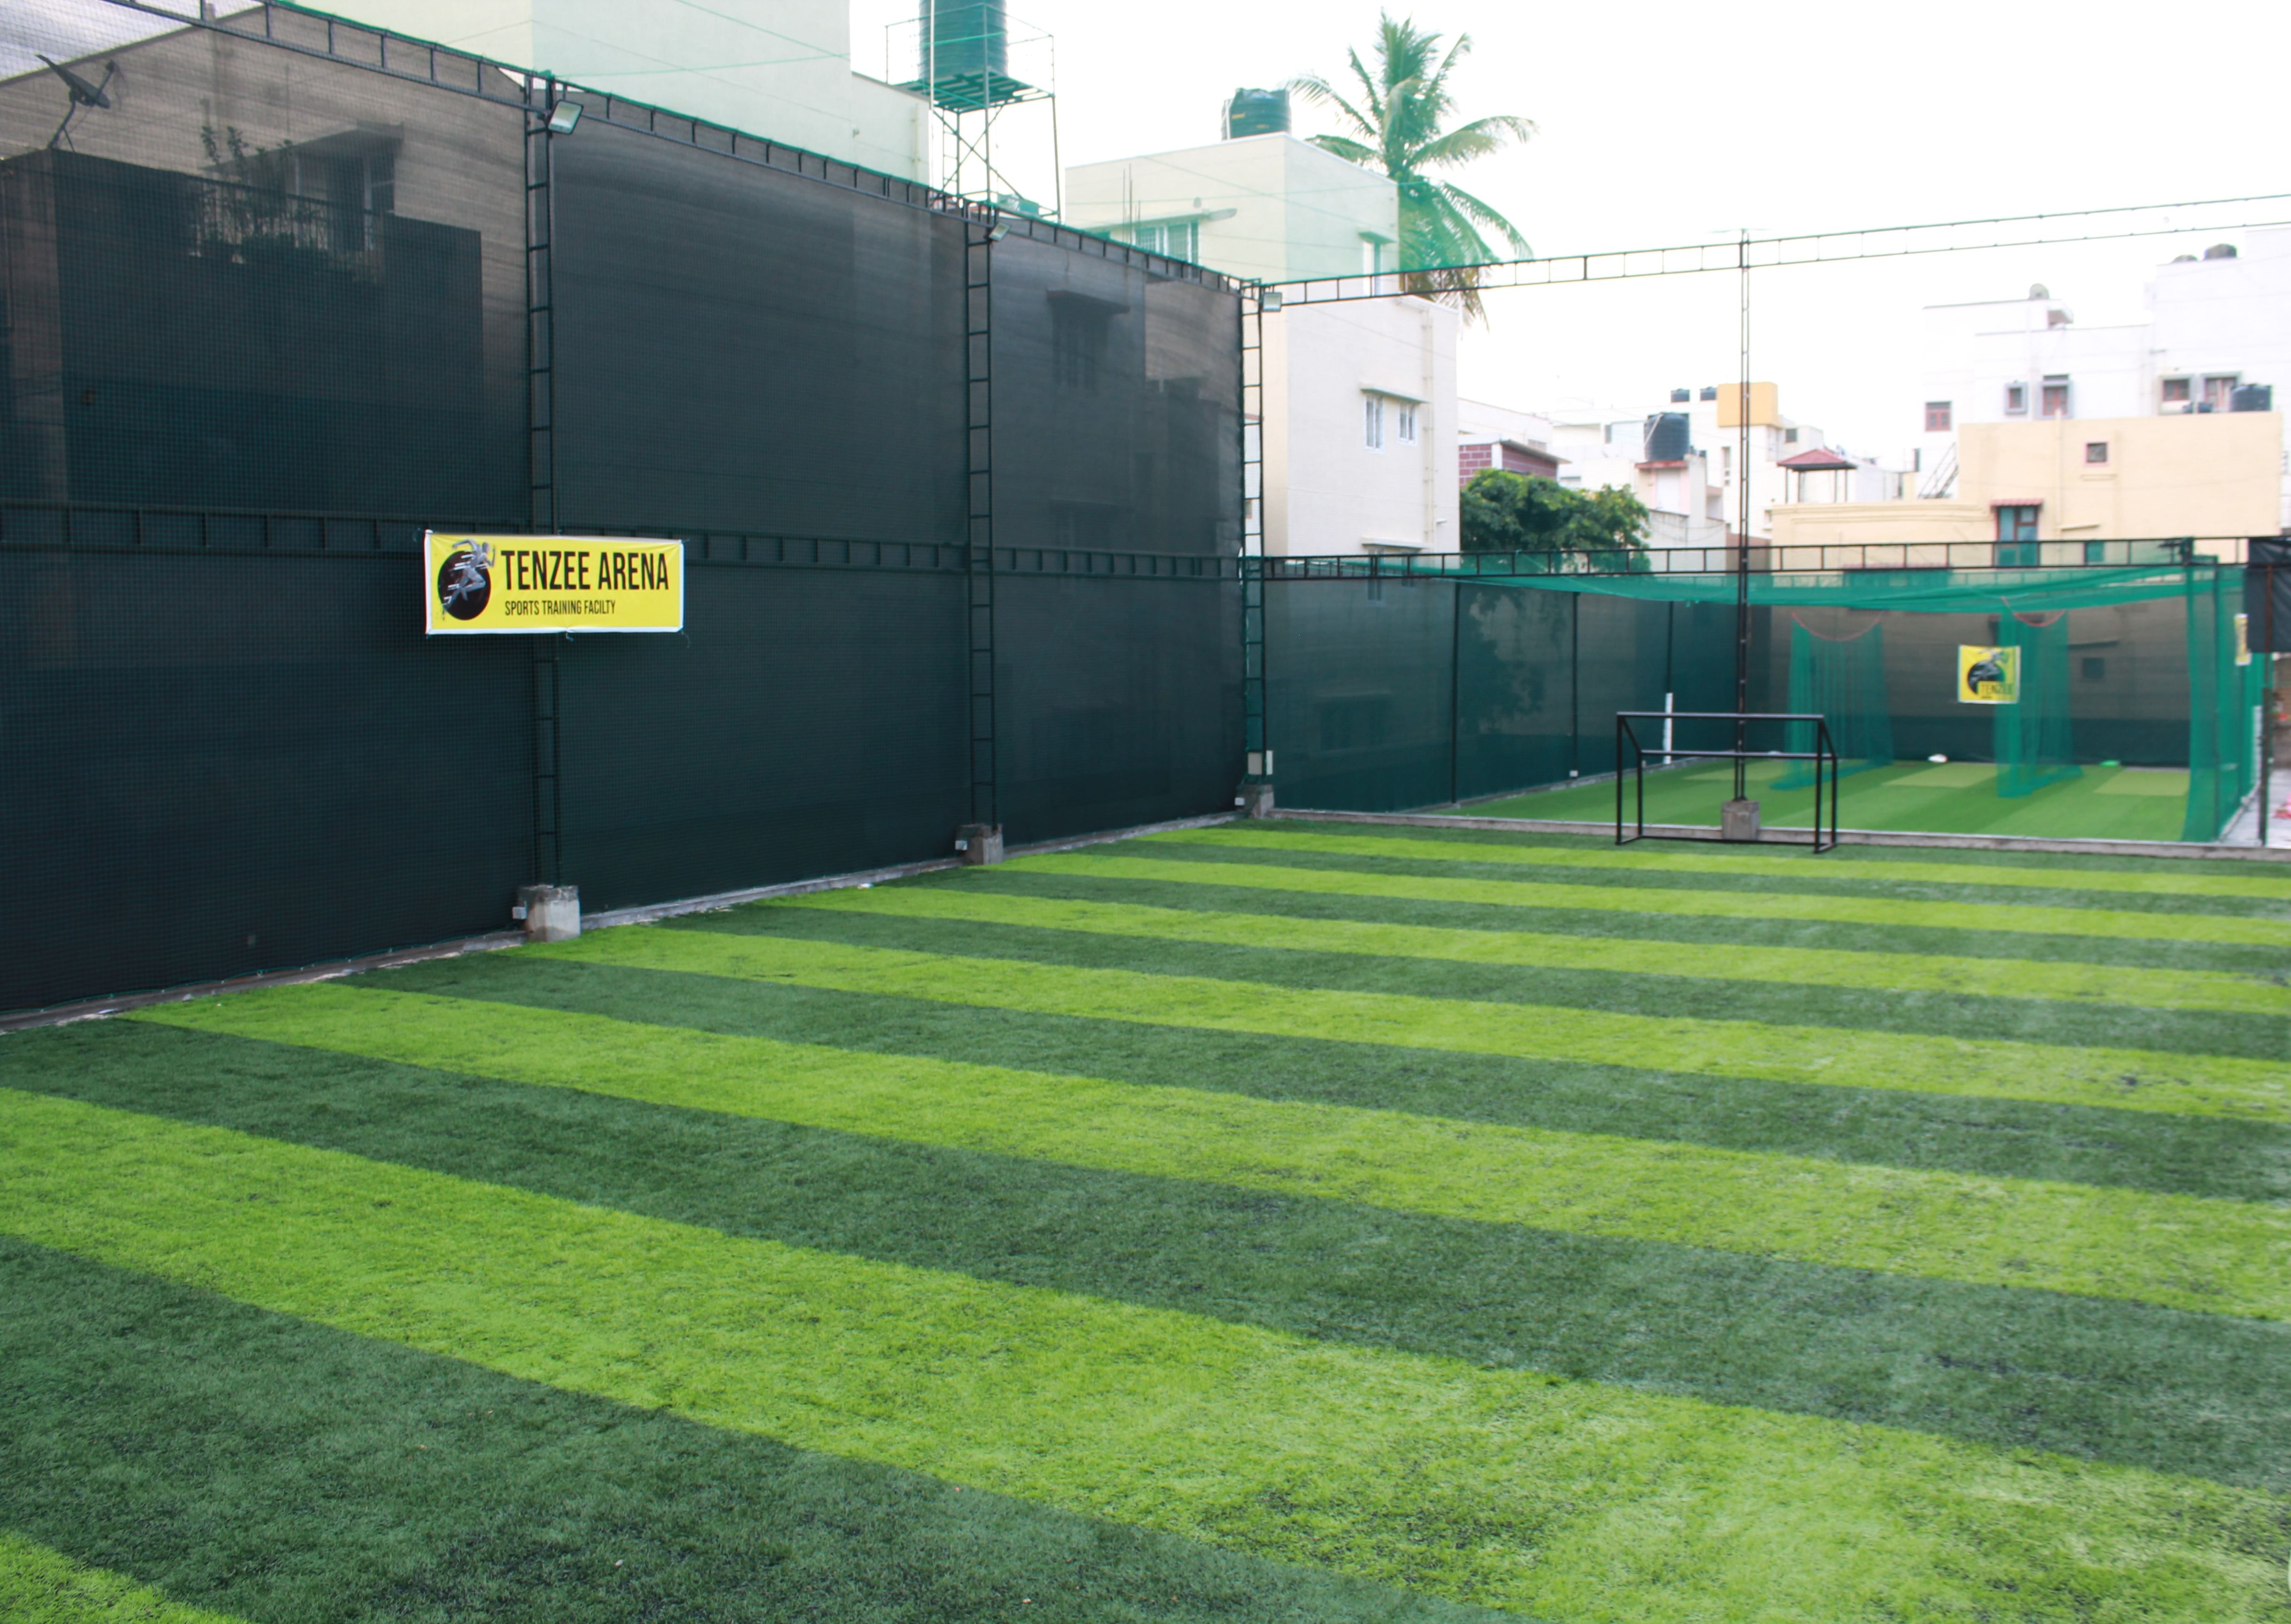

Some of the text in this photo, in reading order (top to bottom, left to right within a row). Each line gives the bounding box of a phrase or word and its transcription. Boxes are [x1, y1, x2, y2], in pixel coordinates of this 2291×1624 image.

[501, 550, 669, 590] TENZEE ARENA
[505, 600, 616, 616] SPORTS TRAINING FACILTY
